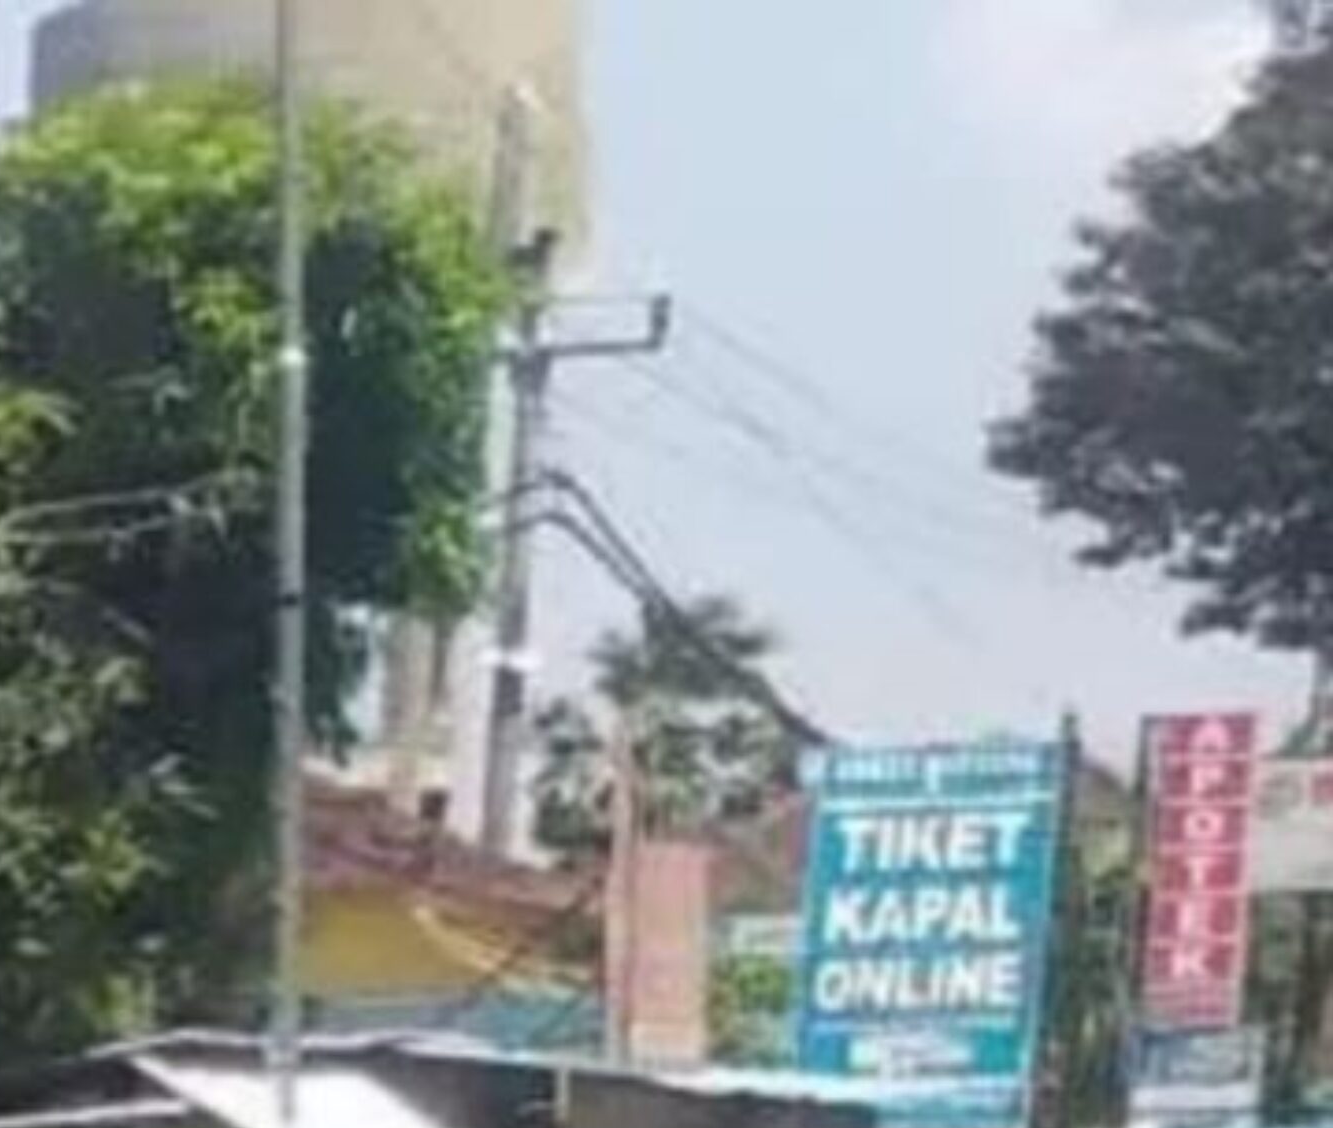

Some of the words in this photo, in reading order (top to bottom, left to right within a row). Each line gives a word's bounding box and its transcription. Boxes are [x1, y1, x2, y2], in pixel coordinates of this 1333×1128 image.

[837, 811, 1030, 872] TIKET
[823, 886, 1020, 945] KAPAL
[813, 951, 1023, 1013] ONLINE
